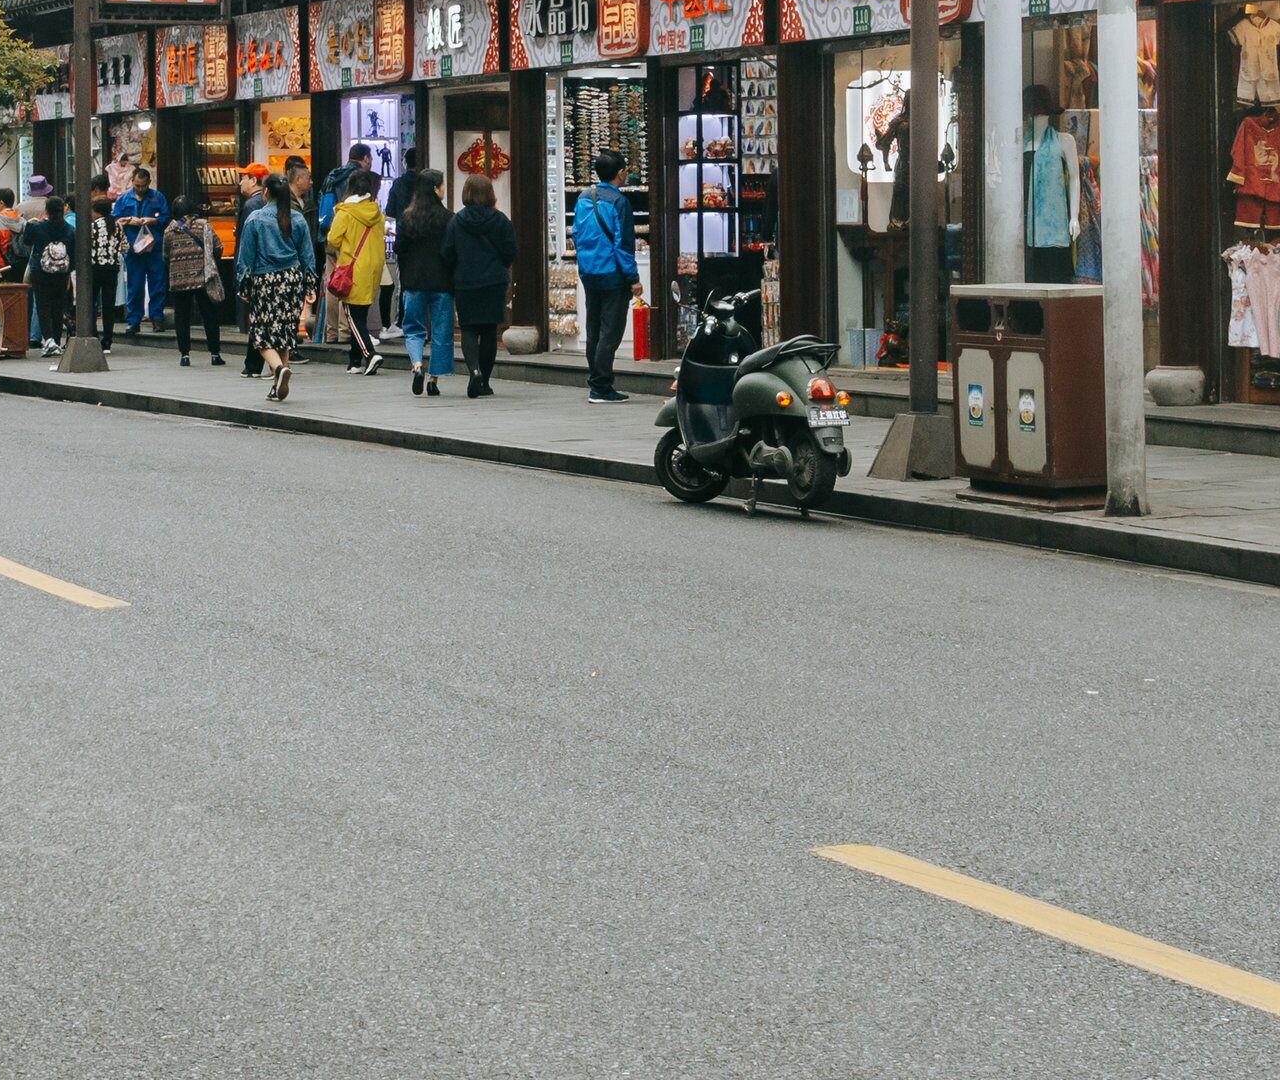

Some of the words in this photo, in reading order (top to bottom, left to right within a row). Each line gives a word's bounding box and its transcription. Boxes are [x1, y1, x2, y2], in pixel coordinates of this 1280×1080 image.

[855, 9, 869, 25] 110
[657, 29, 687, 52] 中国红
[692, 28, 703, 42] 112
